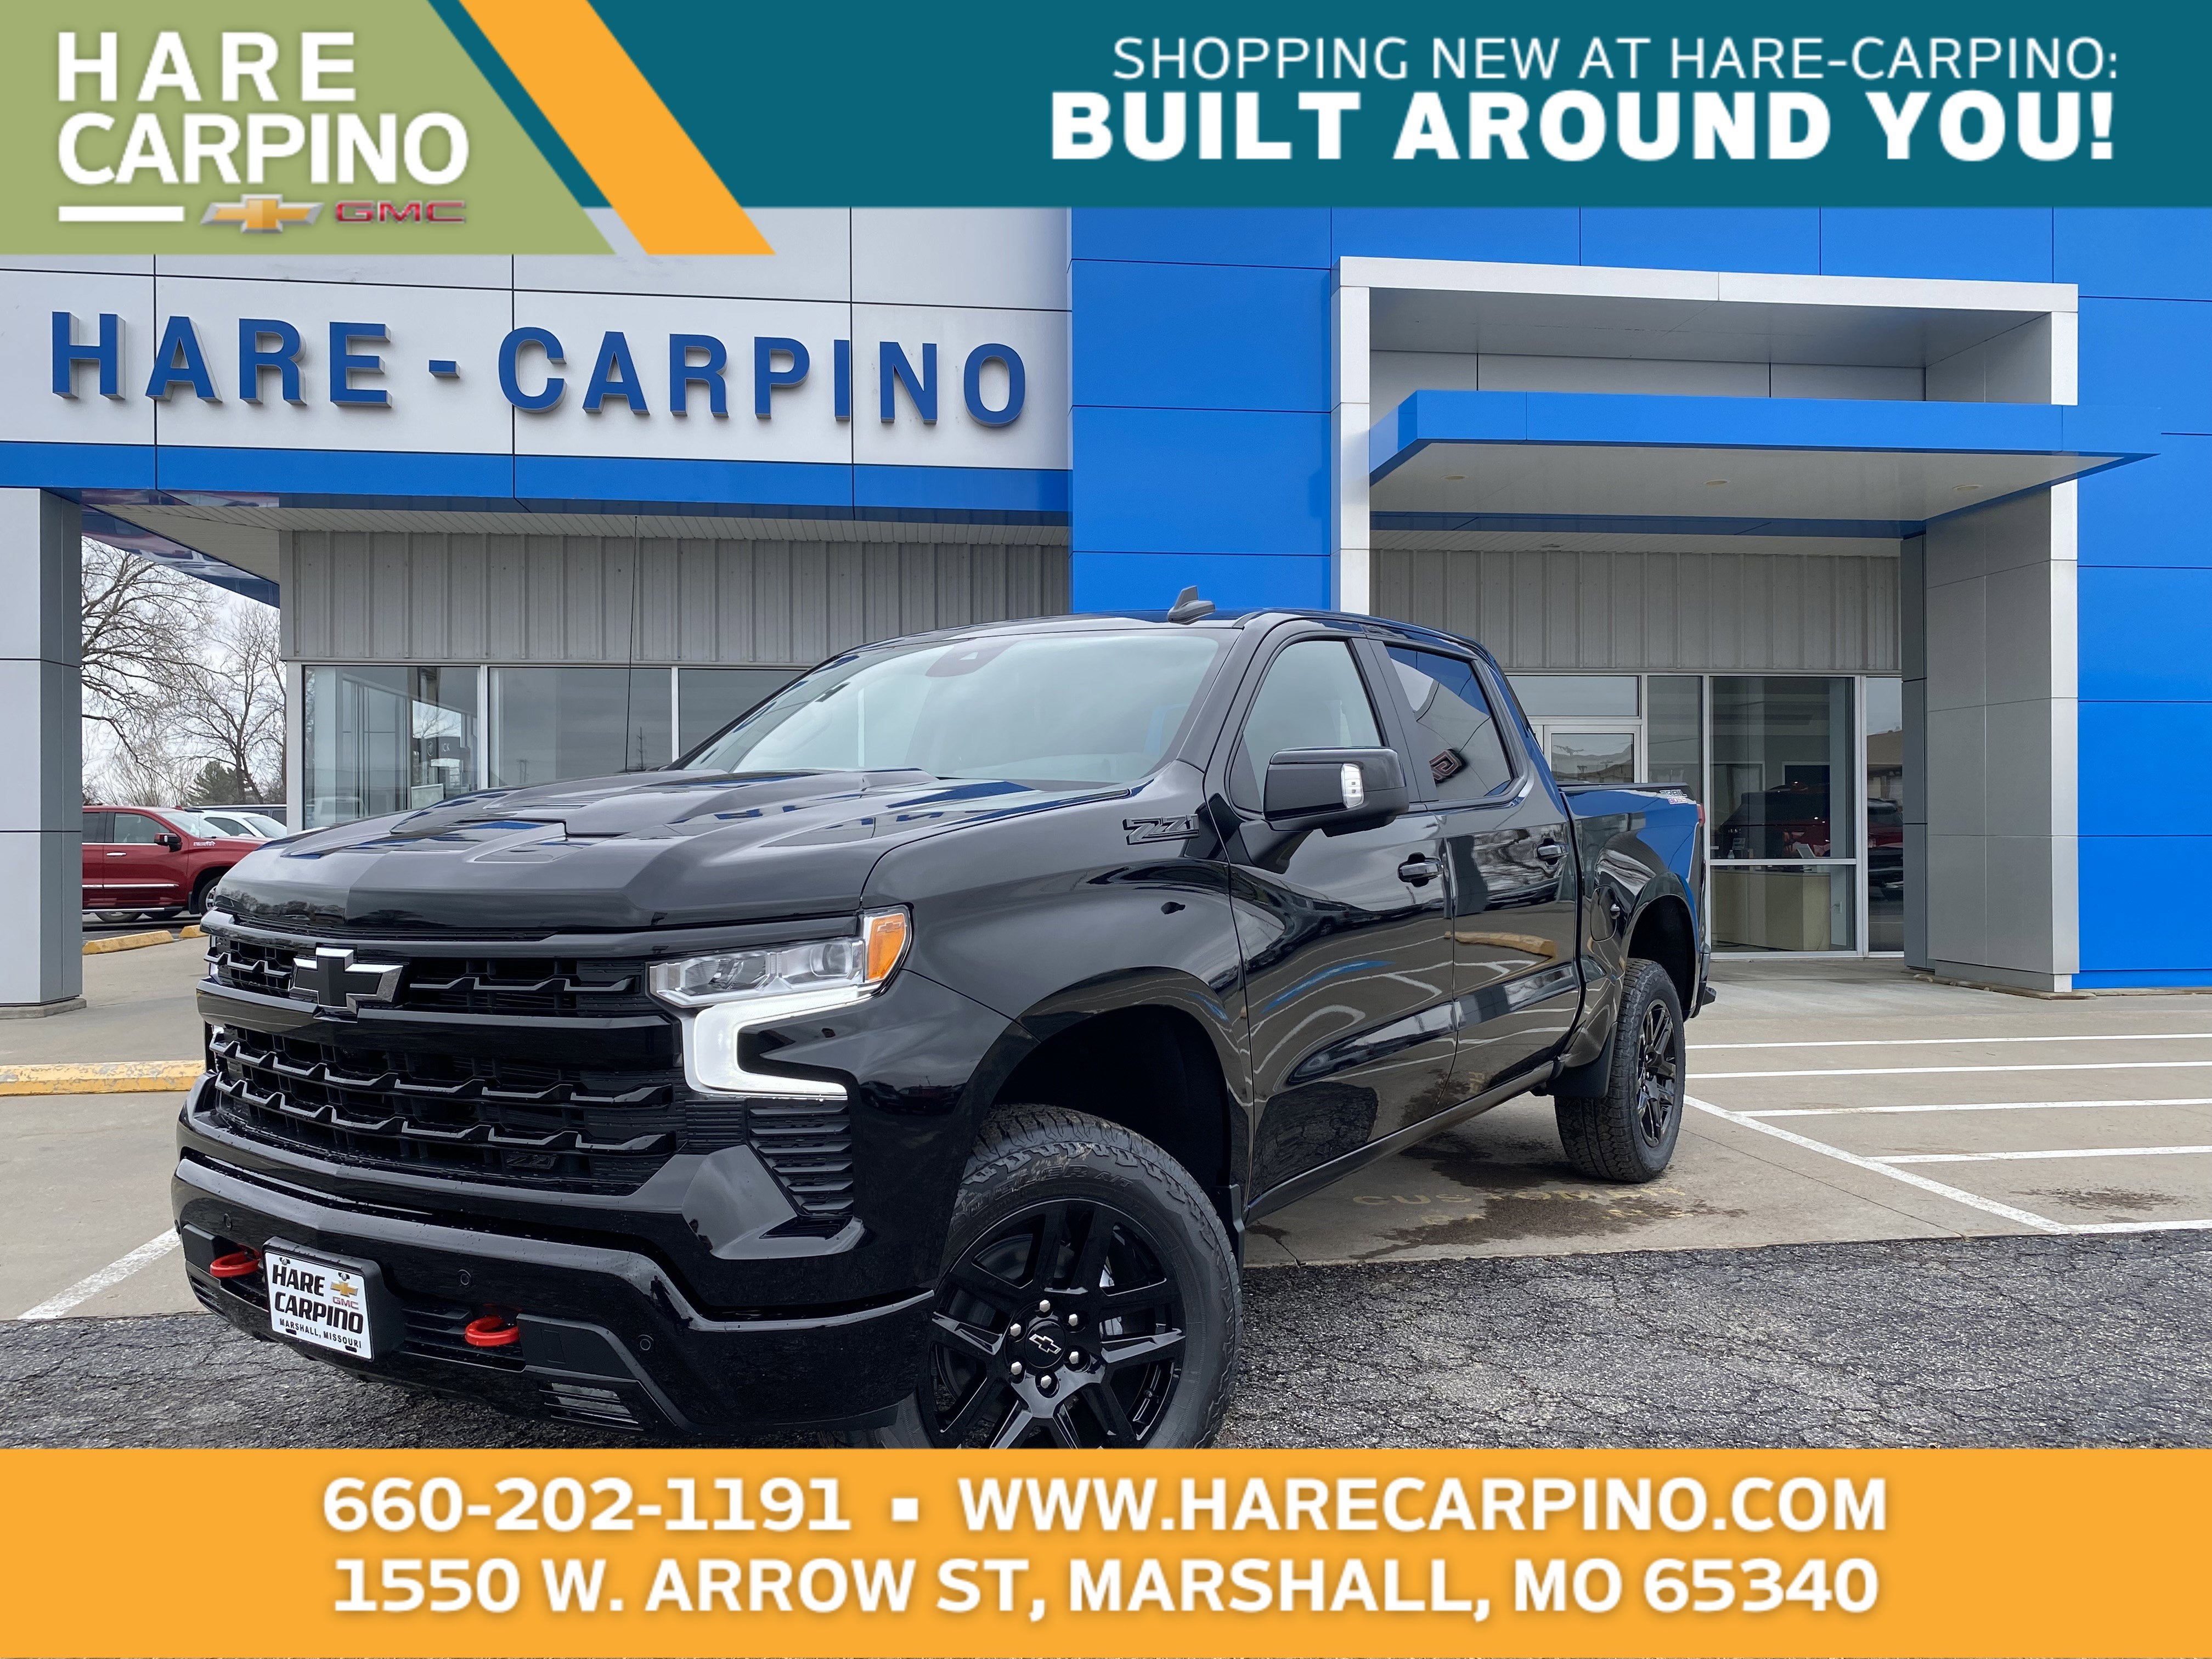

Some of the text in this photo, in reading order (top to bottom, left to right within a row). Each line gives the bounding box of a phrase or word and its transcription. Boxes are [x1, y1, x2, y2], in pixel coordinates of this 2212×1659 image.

[52, 312, 393, 408] HARE
[498, 326, 1026, 427] CARPINO
[441, 743, 450, 752] ICK
[1660, 789, 1688, 798] TRAIL
[1122, 814, 1200, 845] Z71
[272, 1264, 325, 1297] HARE
[275, 1291, 363, 1334] CARPINO
[332, 1296, 359, 1310] GMC
[280, 1318, 362, 1348] MARSHALL, MISSOURI
